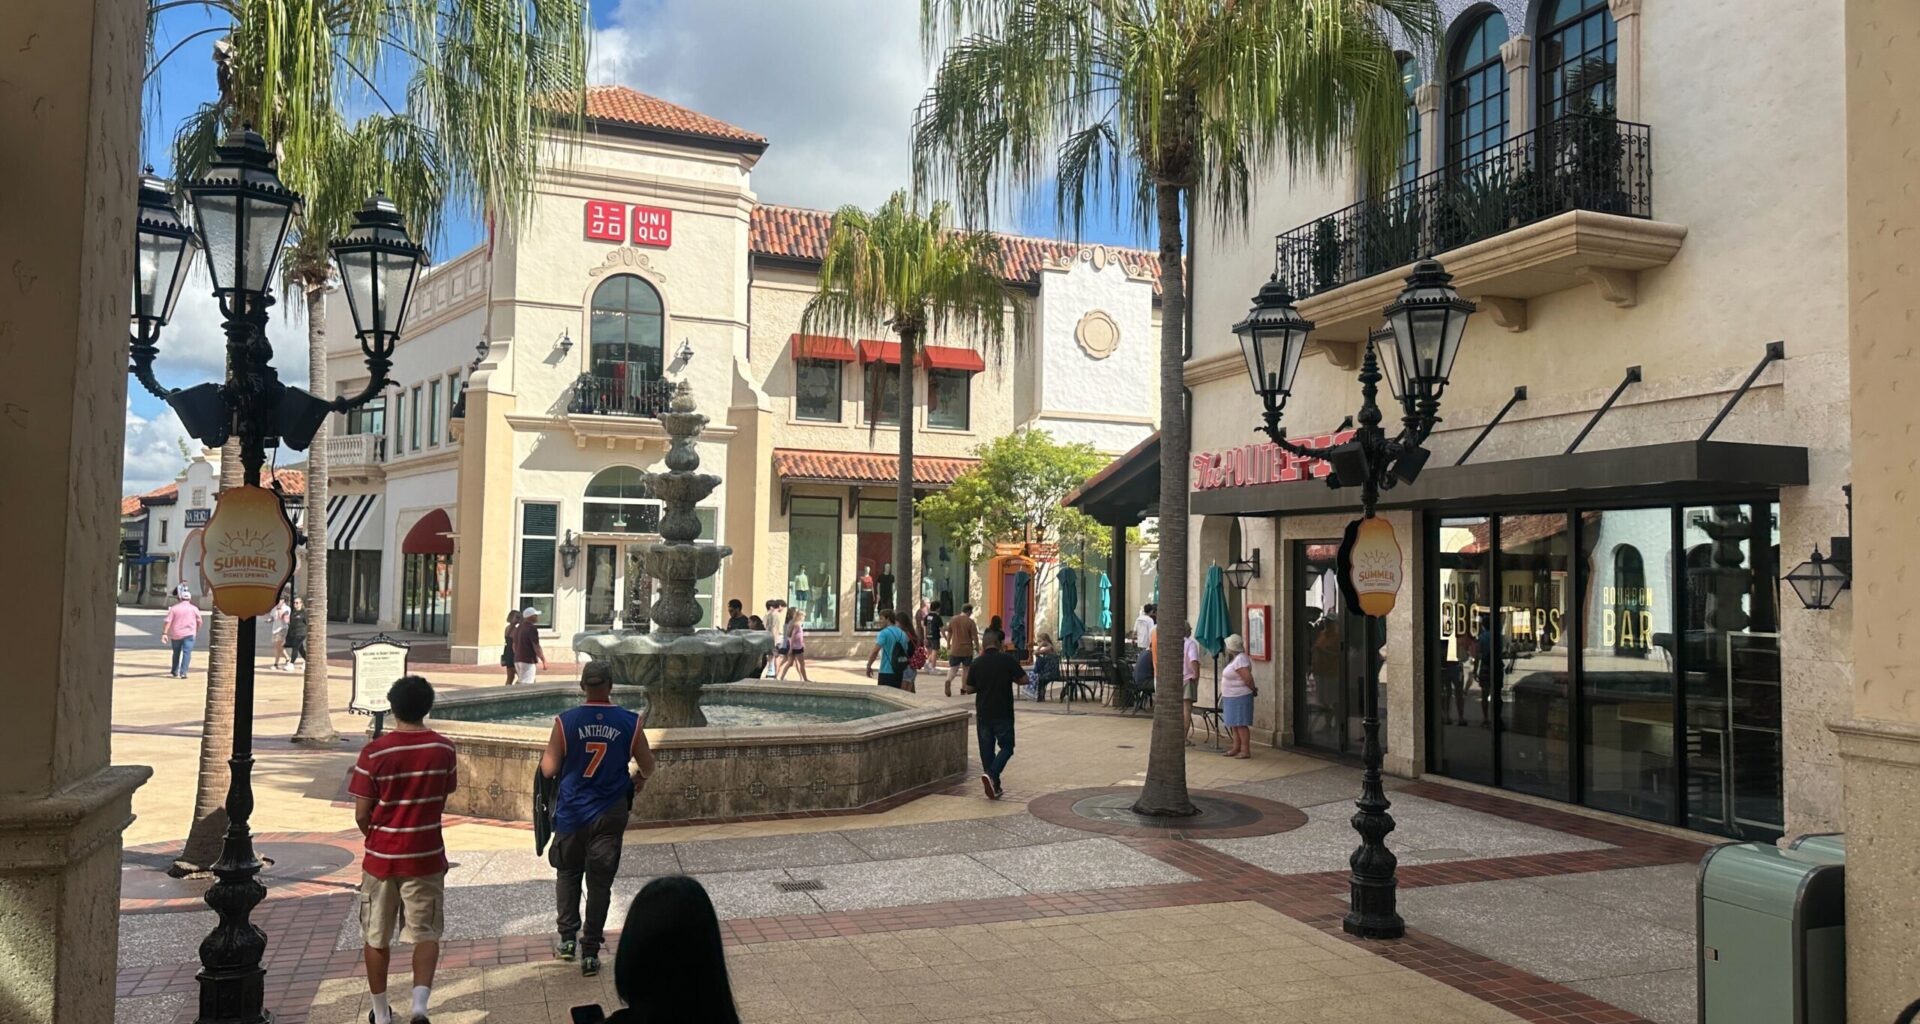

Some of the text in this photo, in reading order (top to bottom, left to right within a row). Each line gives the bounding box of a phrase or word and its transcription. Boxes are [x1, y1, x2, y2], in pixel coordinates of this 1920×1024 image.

[639, 212, 666, 226] UNI
[639, 227, 668, 241] QLO
[1193, 452, 1225, 489] The
[1225, 442, 1282, 487] POLITE
[213, 556, 278, 572] SUMMER
[1358, 570, 1395, 583] SUMMER
[1603, 586, 1653, 607] BOURBON
[1603, 609, 1654, 649] BAR
[578, 724, 621, 742] ANTHONY
[583, 741, 608, 778] 7
